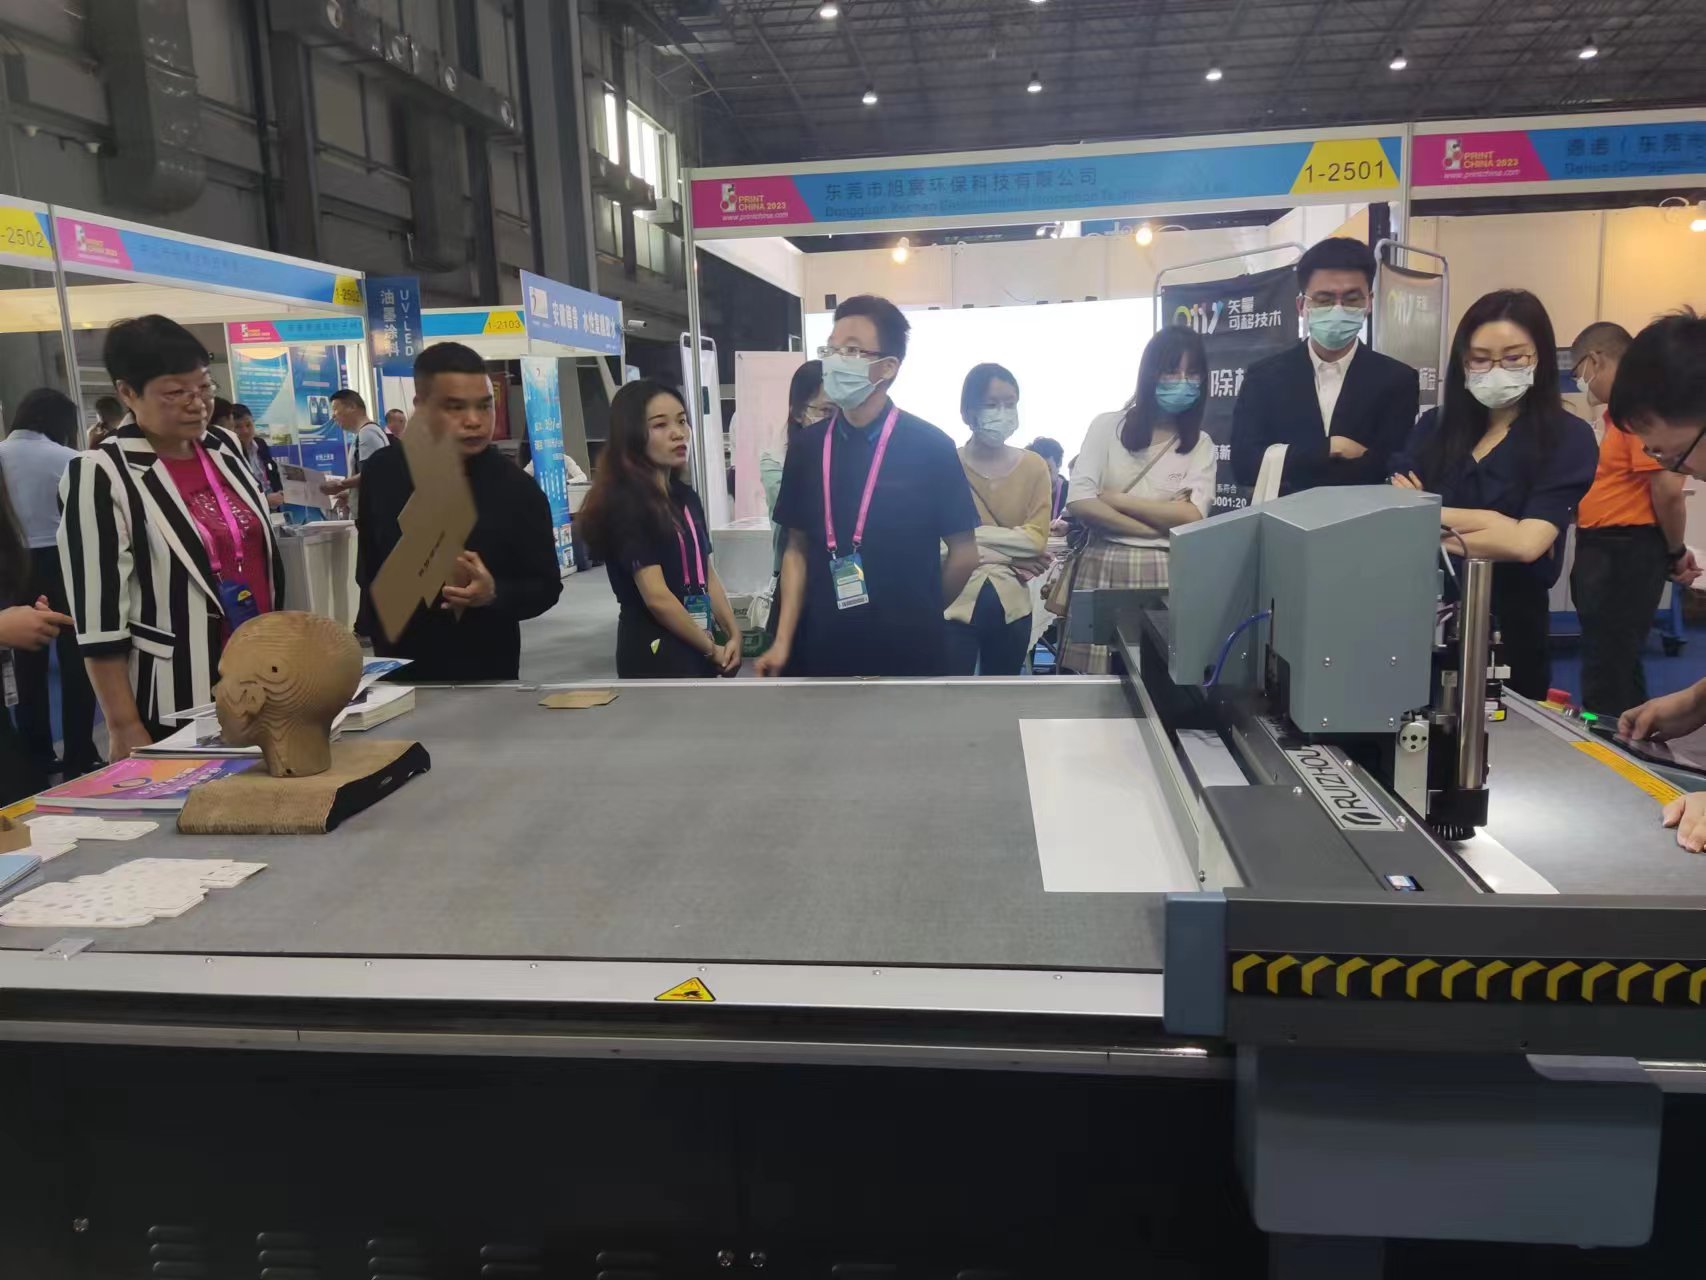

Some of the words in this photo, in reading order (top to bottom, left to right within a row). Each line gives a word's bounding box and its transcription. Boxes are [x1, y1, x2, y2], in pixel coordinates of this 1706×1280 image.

[1464, 151, 1494, 160] PRINT
[1464, 160, 1494, 168] CHINA
[1496, 158, 1519, 167] 2023
[1304, 160, 1384, 183] 1-2501
[739, 194, 765, 203] PRINT
[739, 203, 765, 211] CHINA
[767, 201, 787, 210] 2023
[1228, 296, 1255, 313] 矢量
[1228, 310, 1282, 331] 可移技术
[1297, 744, 1369, 810] RUIZHOU
